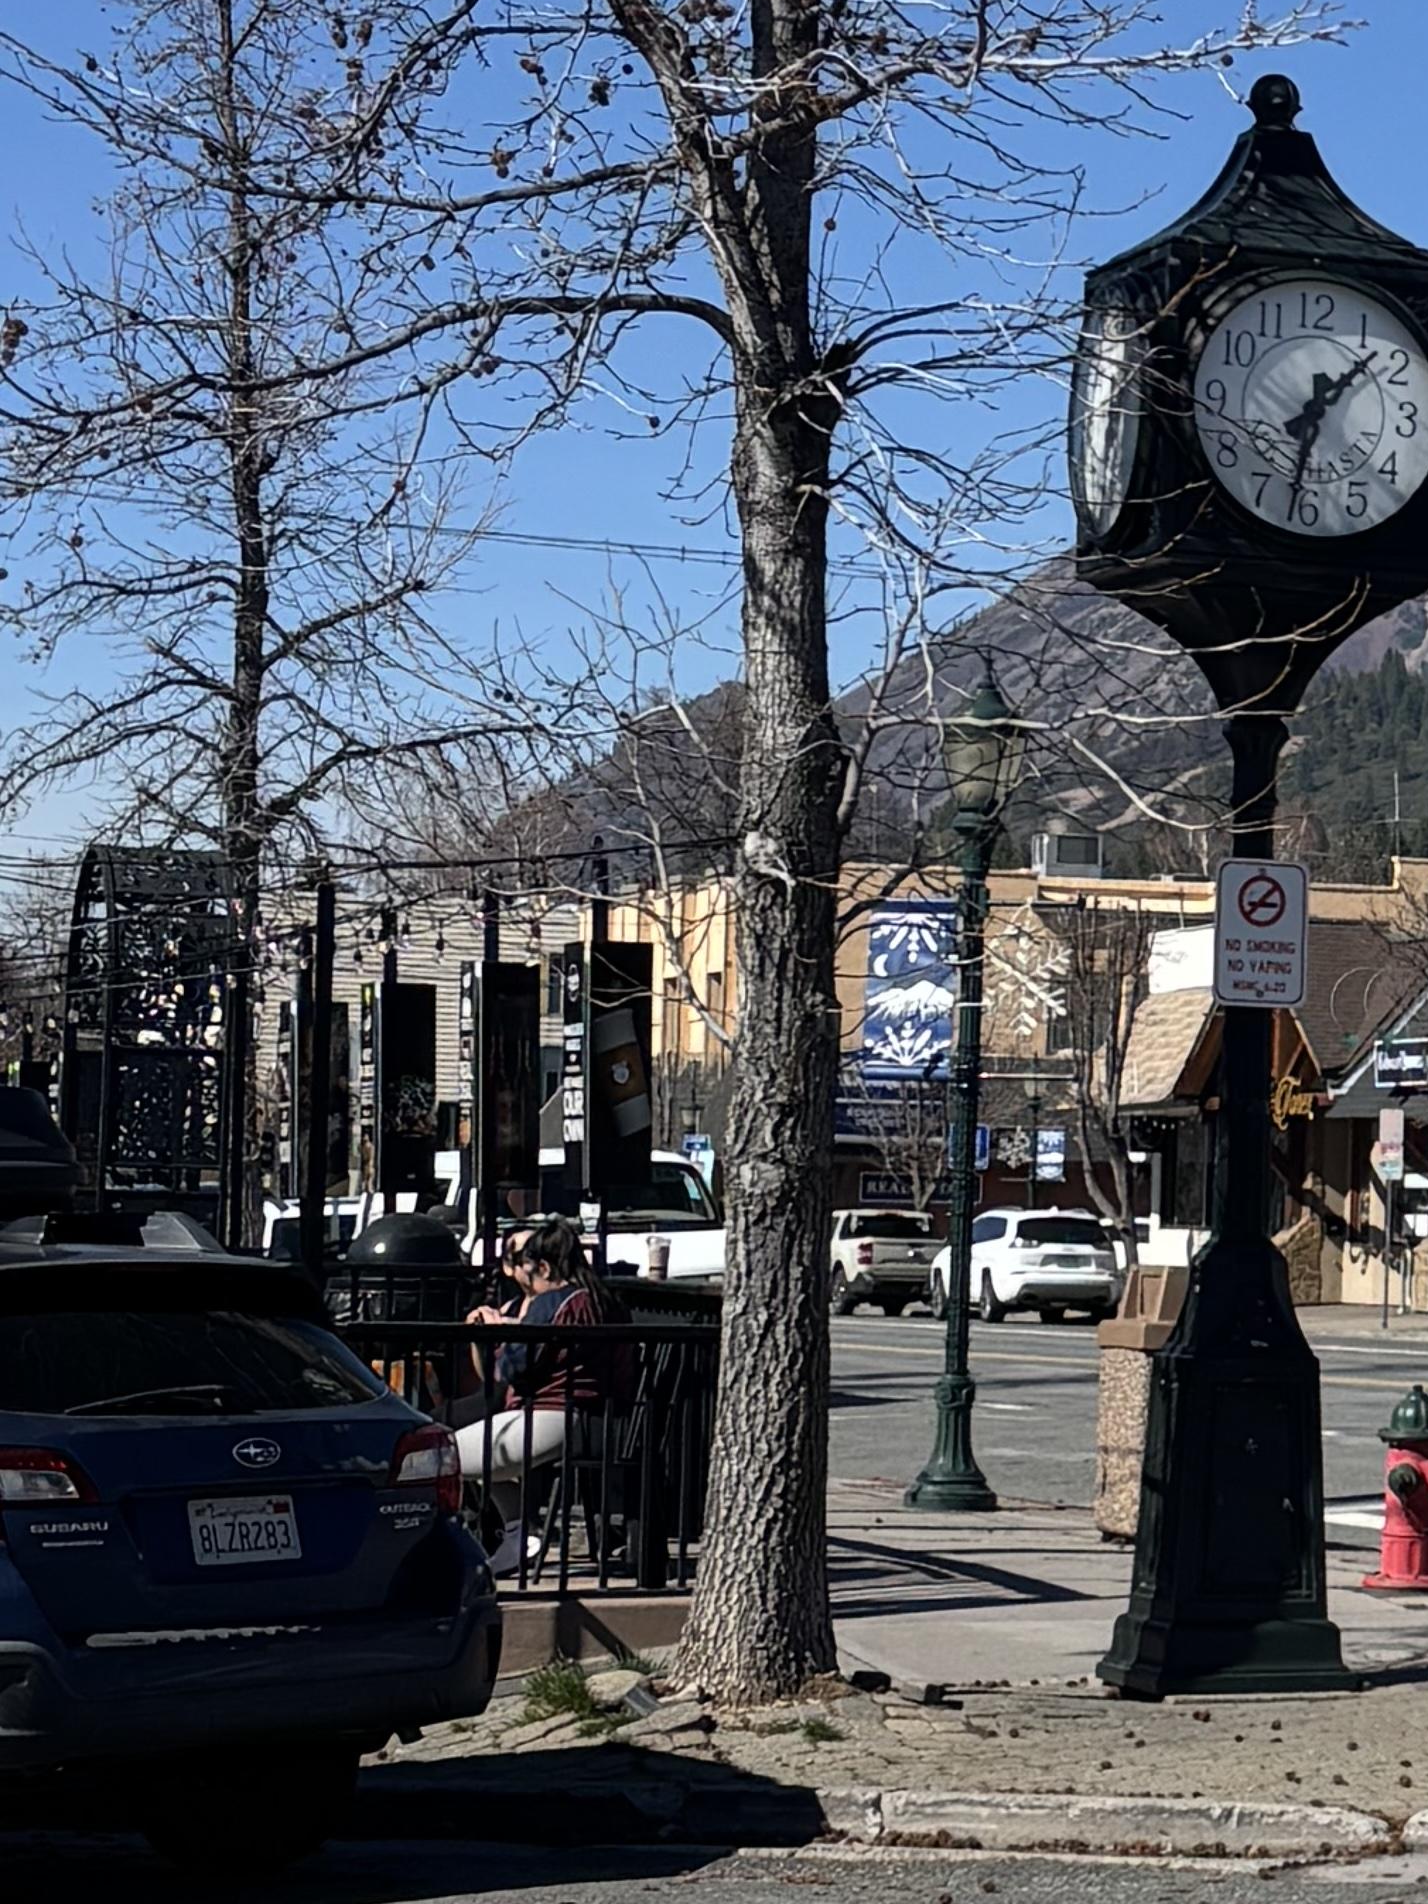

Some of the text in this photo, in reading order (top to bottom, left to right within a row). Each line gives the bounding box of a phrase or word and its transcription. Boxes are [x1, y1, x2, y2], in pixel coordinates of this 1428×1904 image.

[1257, 300, 1283, 340] 11
[1299, 291, 1335, 331] 12
[1222, 329, 1256, 368] 10
[1358, 313, 1369, 349] 1
[1387, 348, 1410, 386] 2
[1205, 379, 1227, 417] 9
[1395, 401, 1418, 438] 3
[1216, 431, 1239, 468] 8
[1377, 450, 1399, 485] 4
[1251, 472, 1272, 508] 7
[1299, 488, 1319, 527] 6
[1345, 481, 1369, 518] 5
[1225, 939, 1297, 954] NO SMOKING
[1227, 959, 1293, 976] NO VAPING
[30, 1521, 109, 1534] SUBARU
[199, 1519, 291, 1554] 8LZR283
